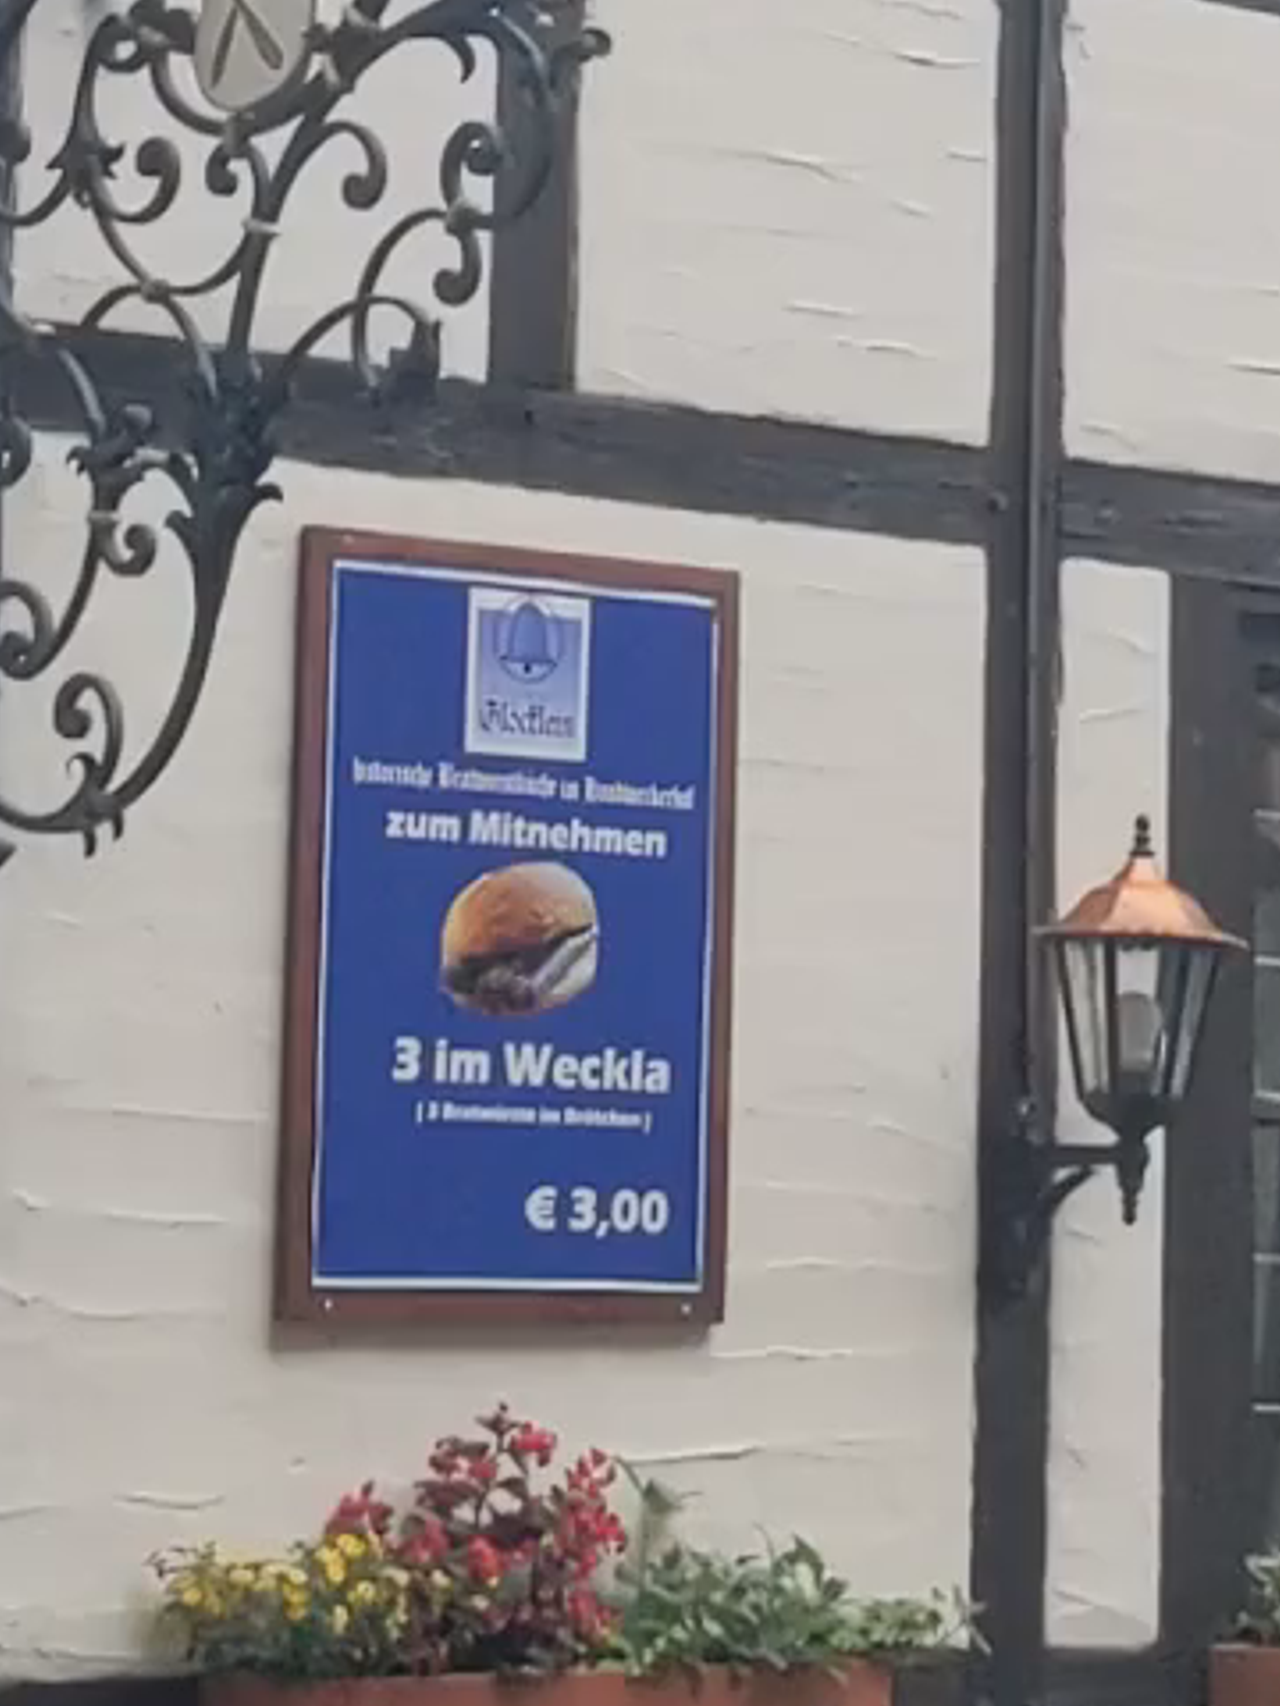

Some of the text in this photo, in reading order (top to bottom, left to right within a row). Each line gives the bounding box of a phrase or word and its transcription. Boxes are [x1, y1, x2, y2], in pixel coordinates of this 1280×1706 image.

[385, 810, 668, 858] zum Mitnehmen
[392, 1035, 671, 1094] 3 im Weckla
[524, 1185, 670, 1238] € 3,00
